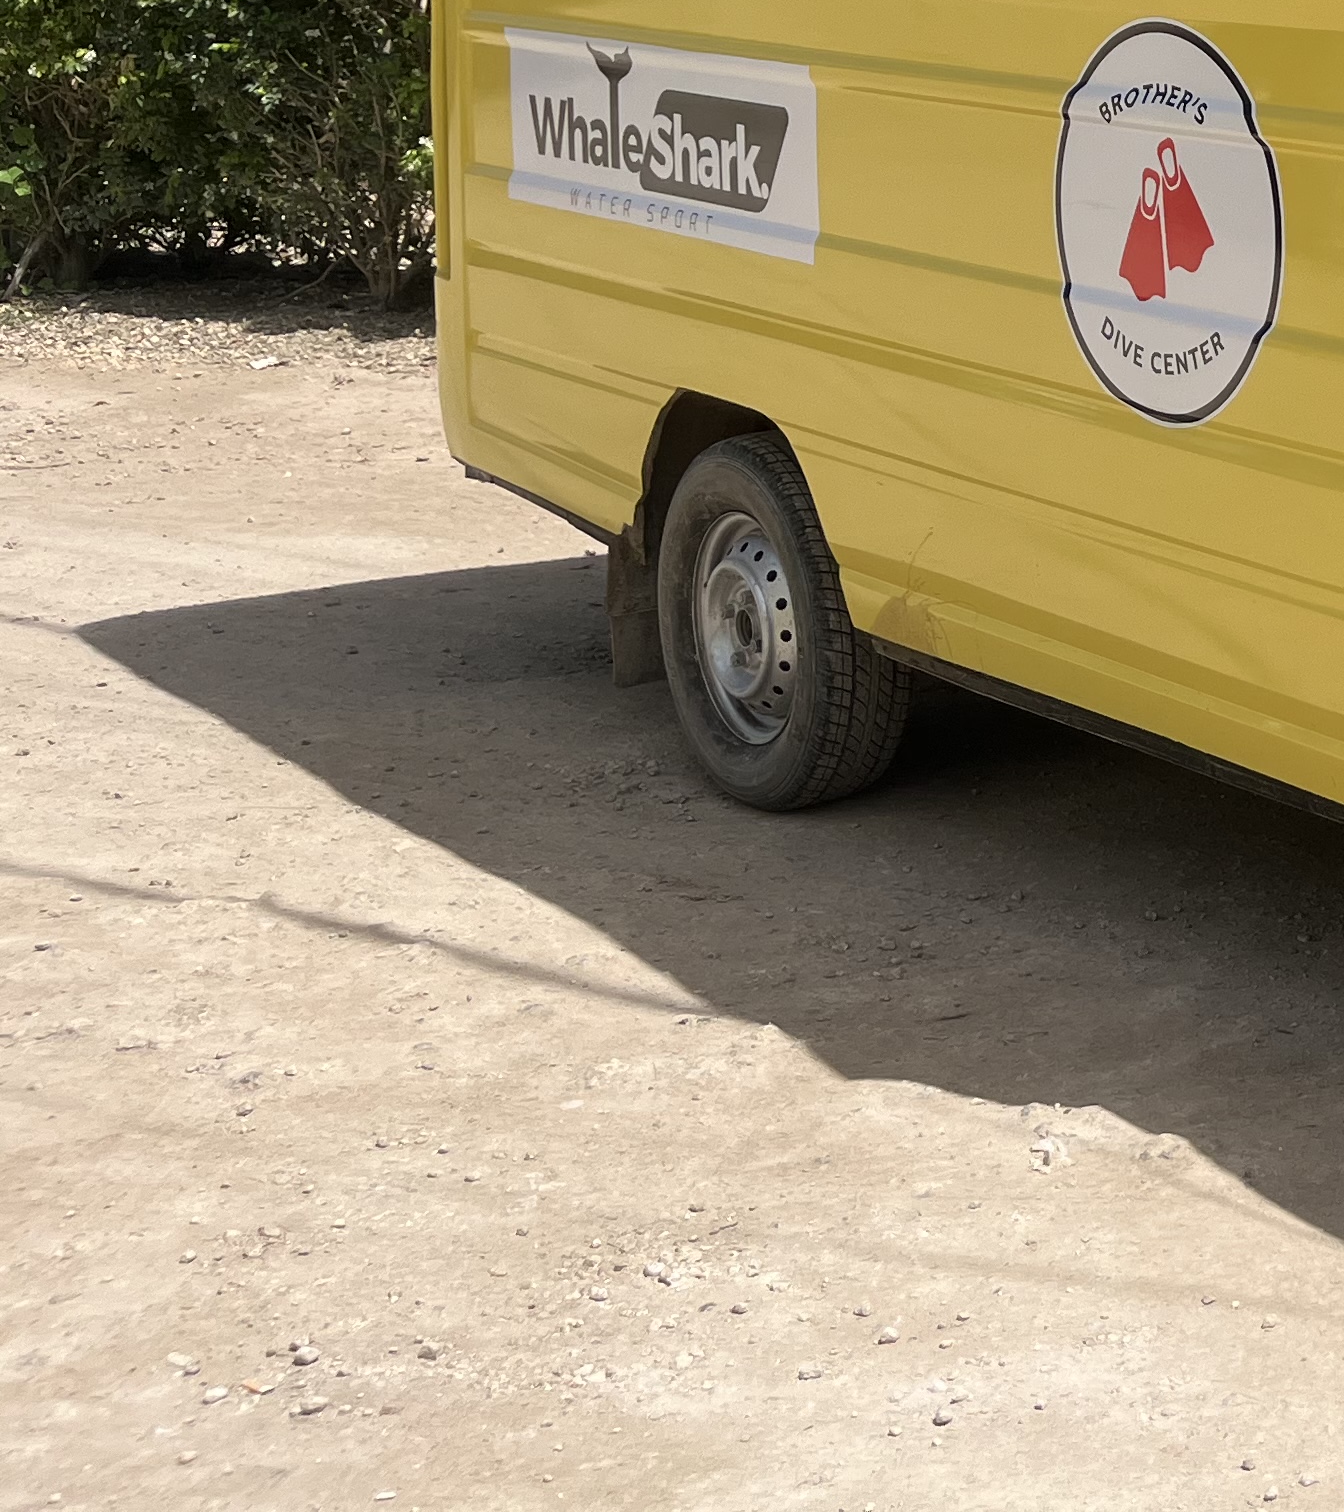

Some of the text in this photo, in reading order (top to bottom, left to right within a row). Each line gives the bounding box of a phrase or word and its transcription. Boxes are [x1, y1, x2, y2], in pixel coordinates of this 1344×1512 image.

[1098, 82, 1208, 125] BROTHER'S
[569, 187, 714, 234] WATER SPORT
[1100, 315, 1225, 376] DIVE CENTER
